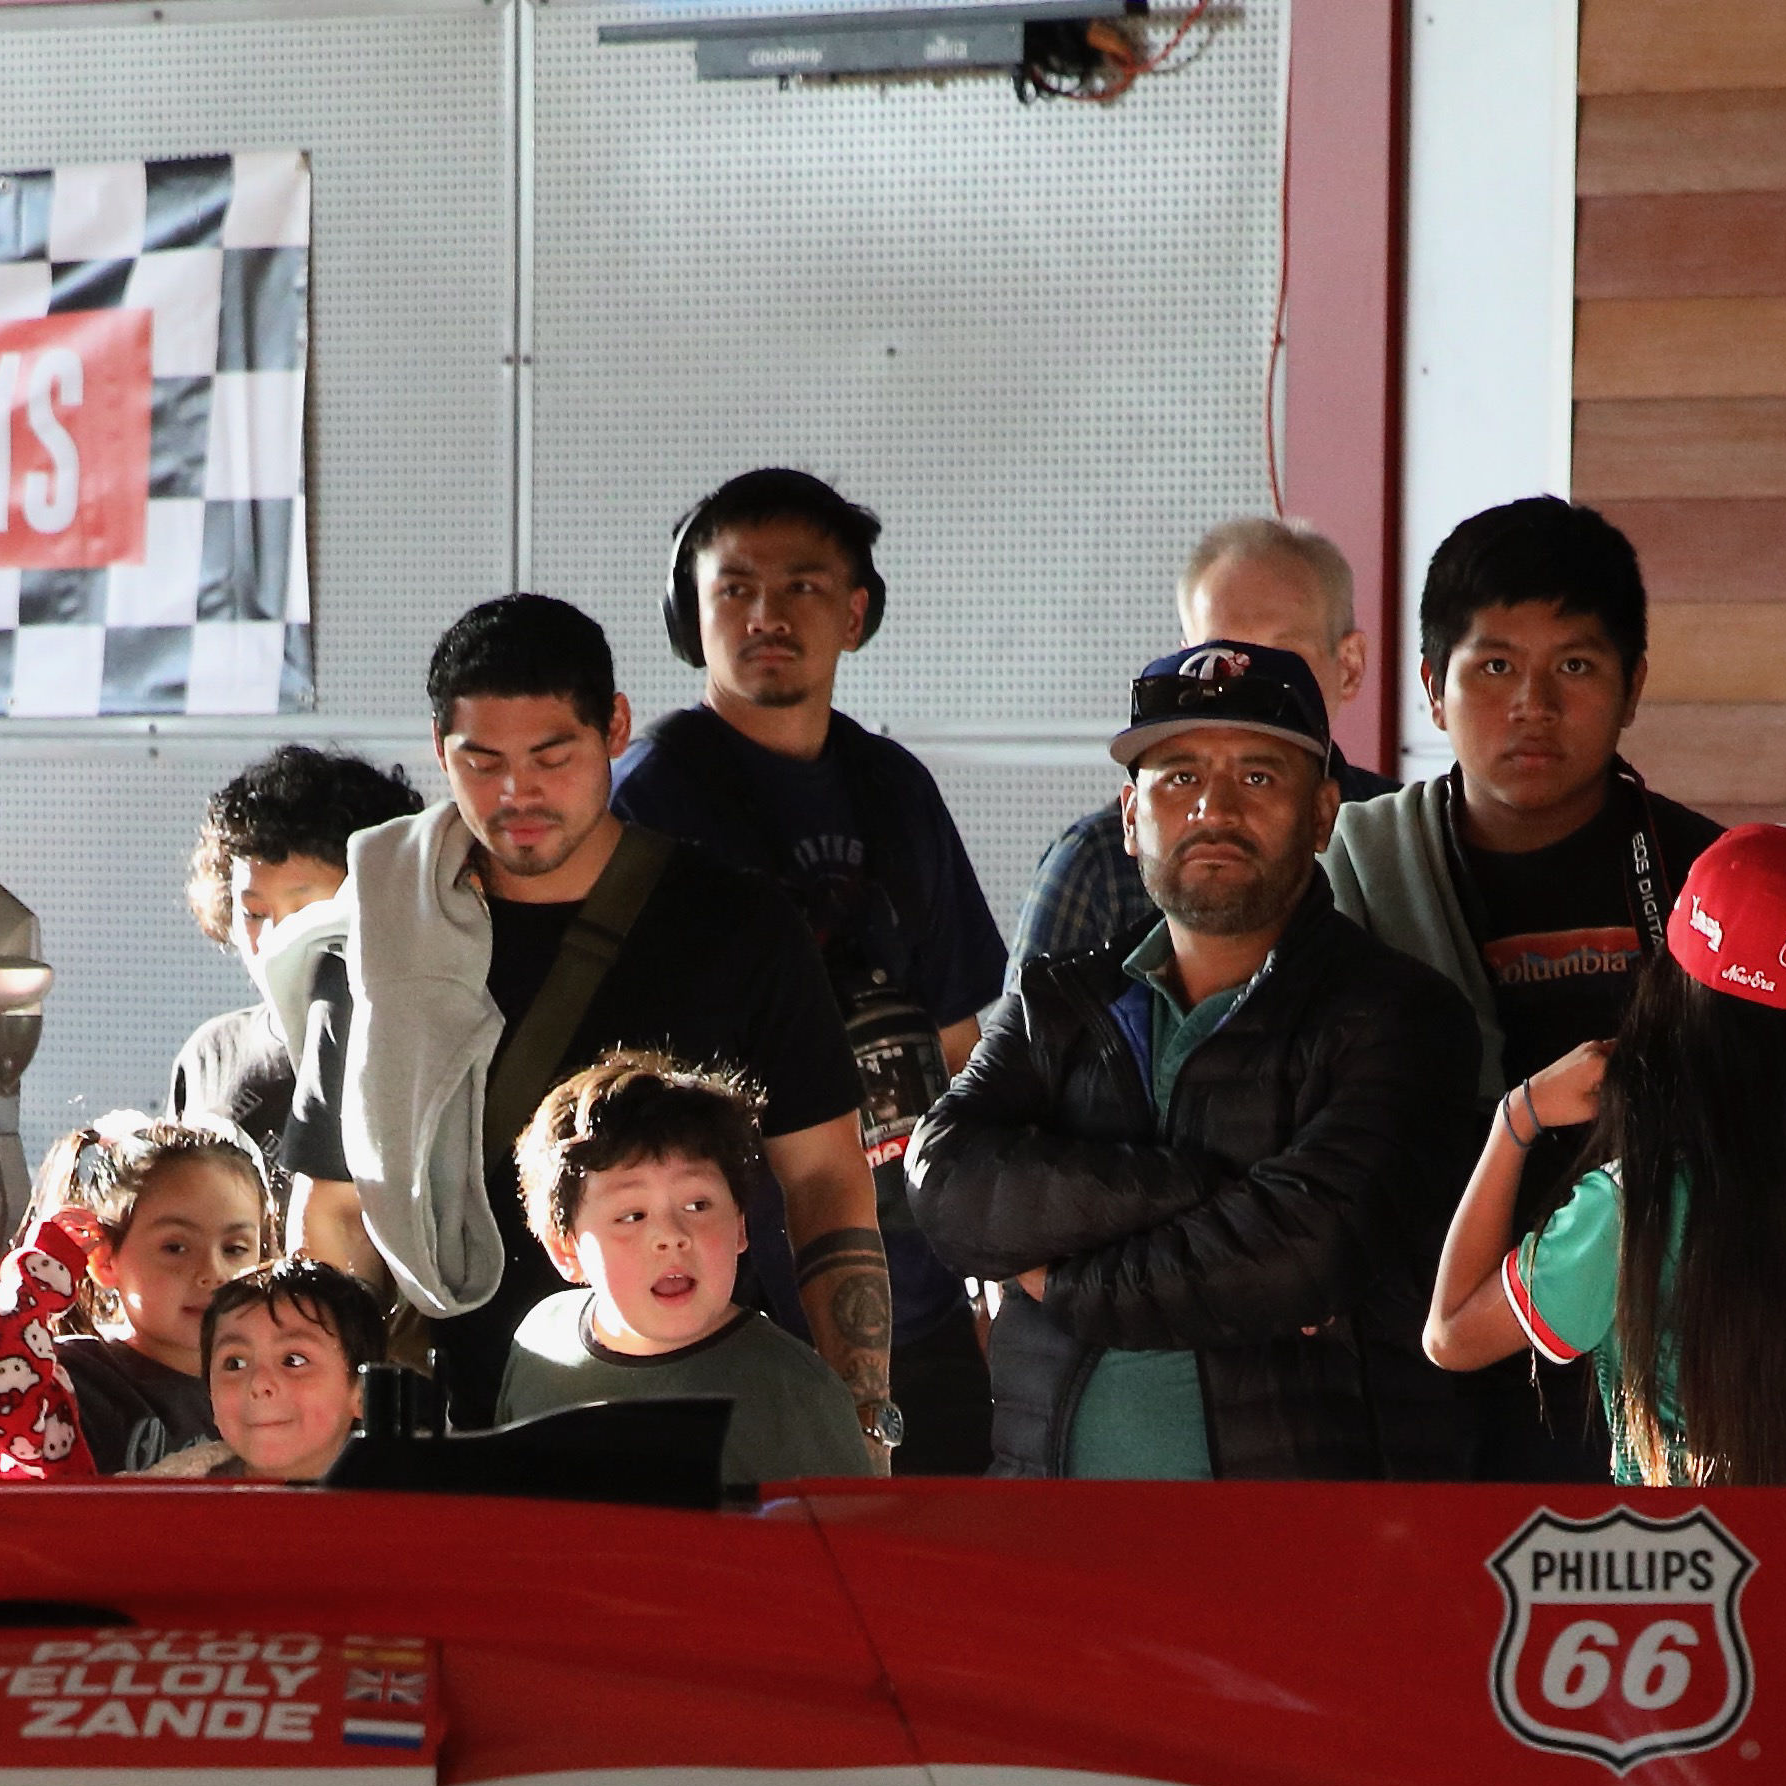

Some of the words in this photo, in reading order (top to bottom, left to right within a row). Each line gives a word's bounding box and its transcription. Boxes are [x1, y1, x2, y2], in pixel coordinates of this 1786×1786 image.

[1632, 831, 1650, 875] EOS
[1638, 878, 1666, 948] DIGITA
[1498, 946, 1628, 984] olumbia
[1530, 1548, 1717, 1595] PHILLIPS
[1540, 1618, 1699, 1711] 66
[18, 1703, 322, 1743] ZANDE
